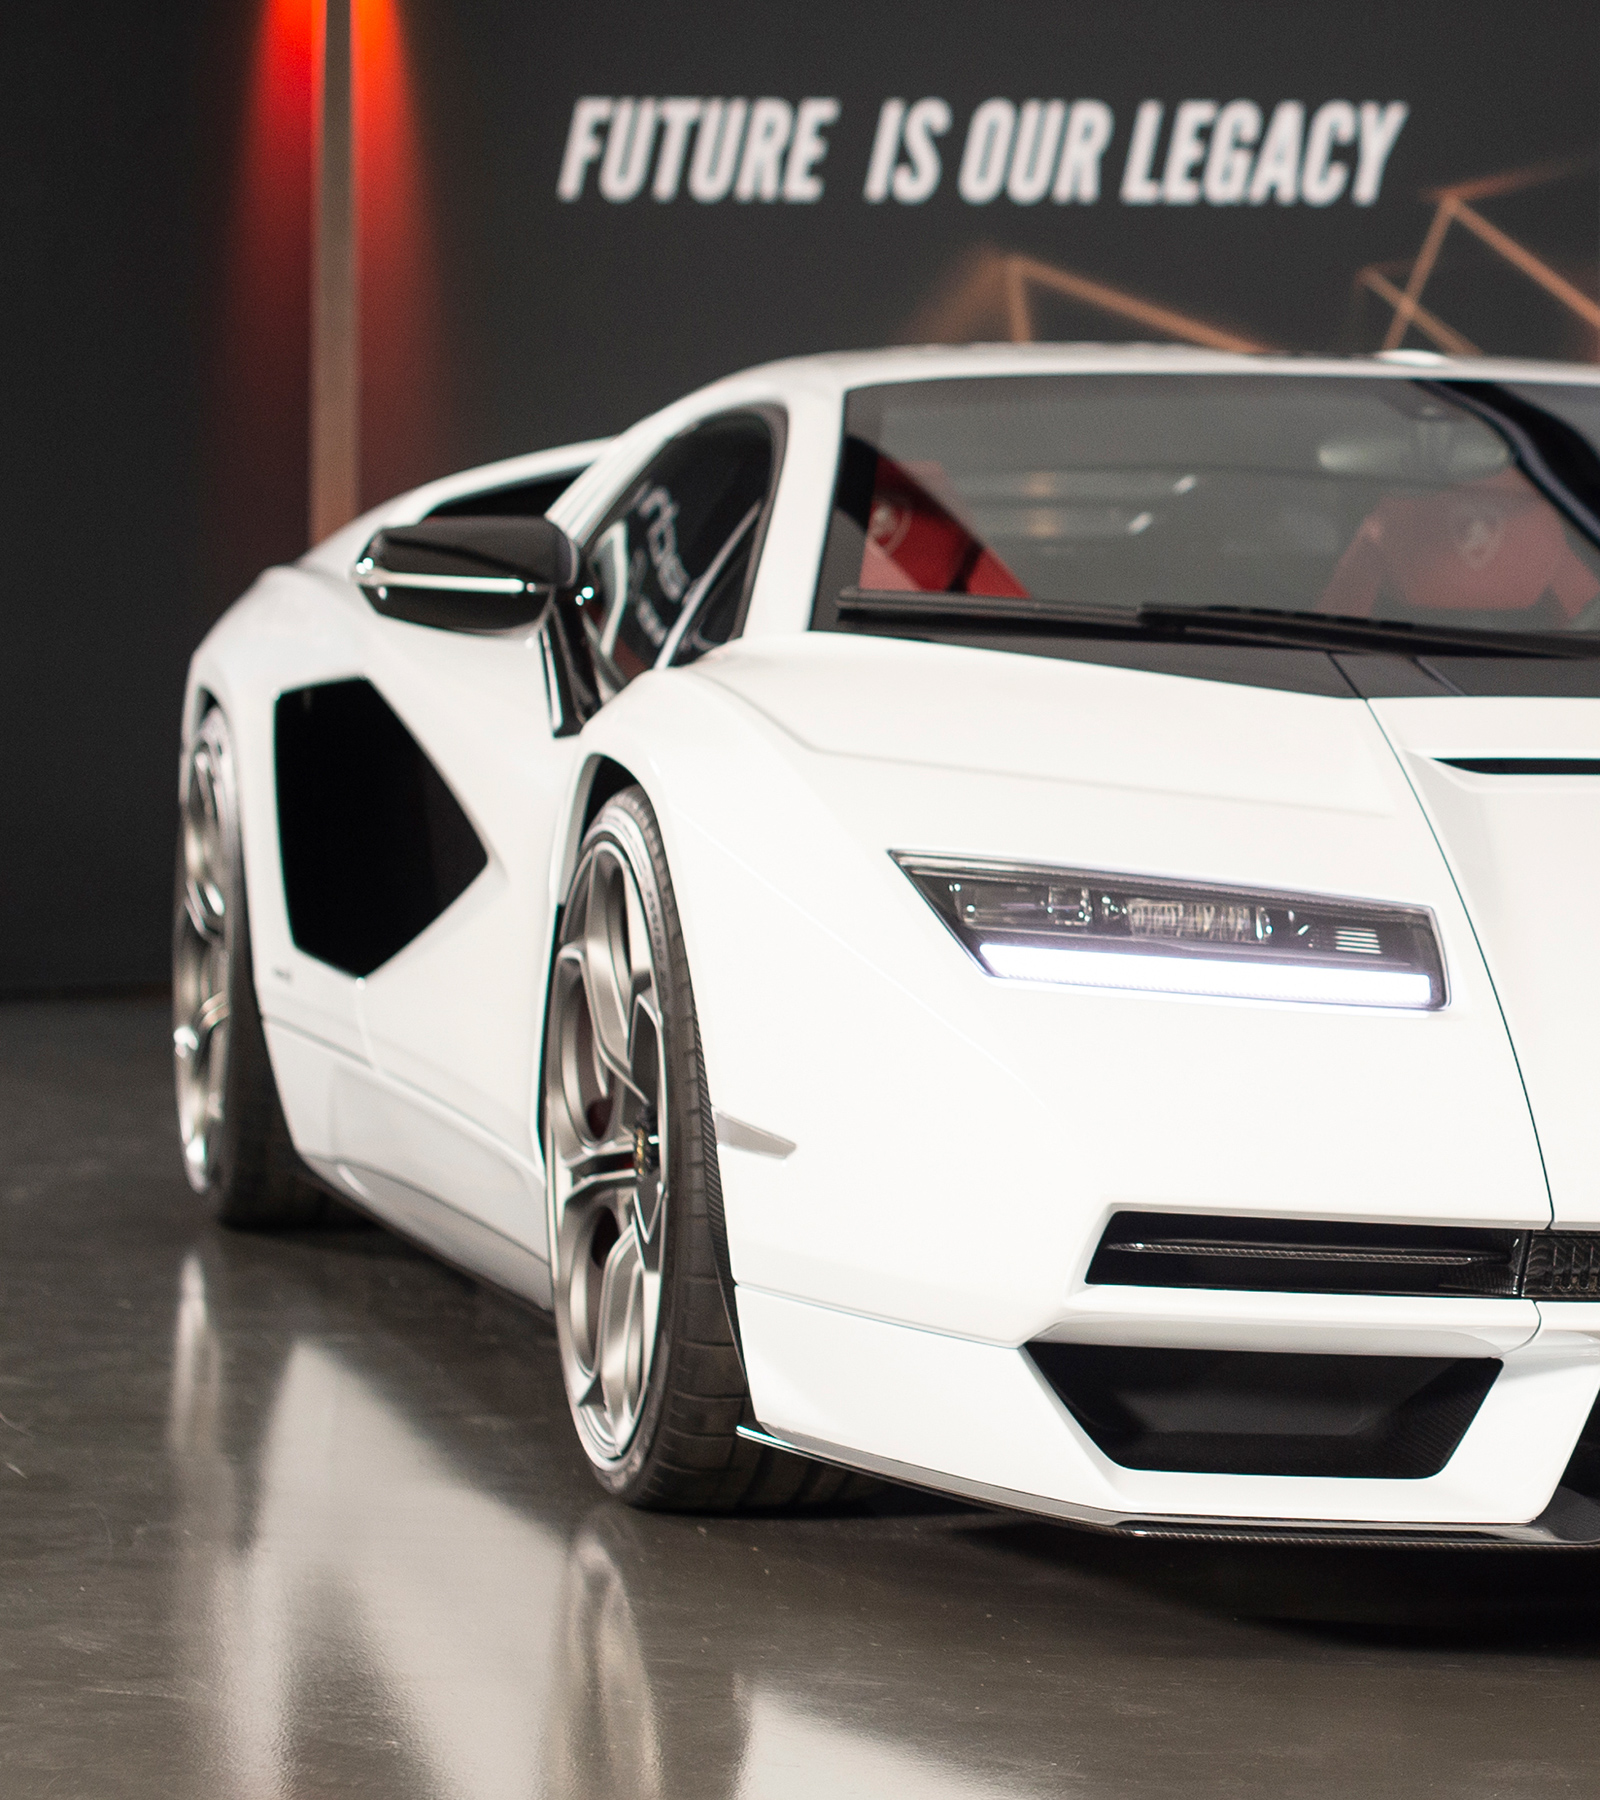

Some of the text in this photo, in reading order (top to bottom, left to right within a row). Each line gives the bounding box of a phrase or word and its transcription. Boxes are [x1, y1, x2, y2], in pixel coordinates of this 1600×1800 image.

[558, 97, 1407, 205] FUTURE IS OUR LEGACY
